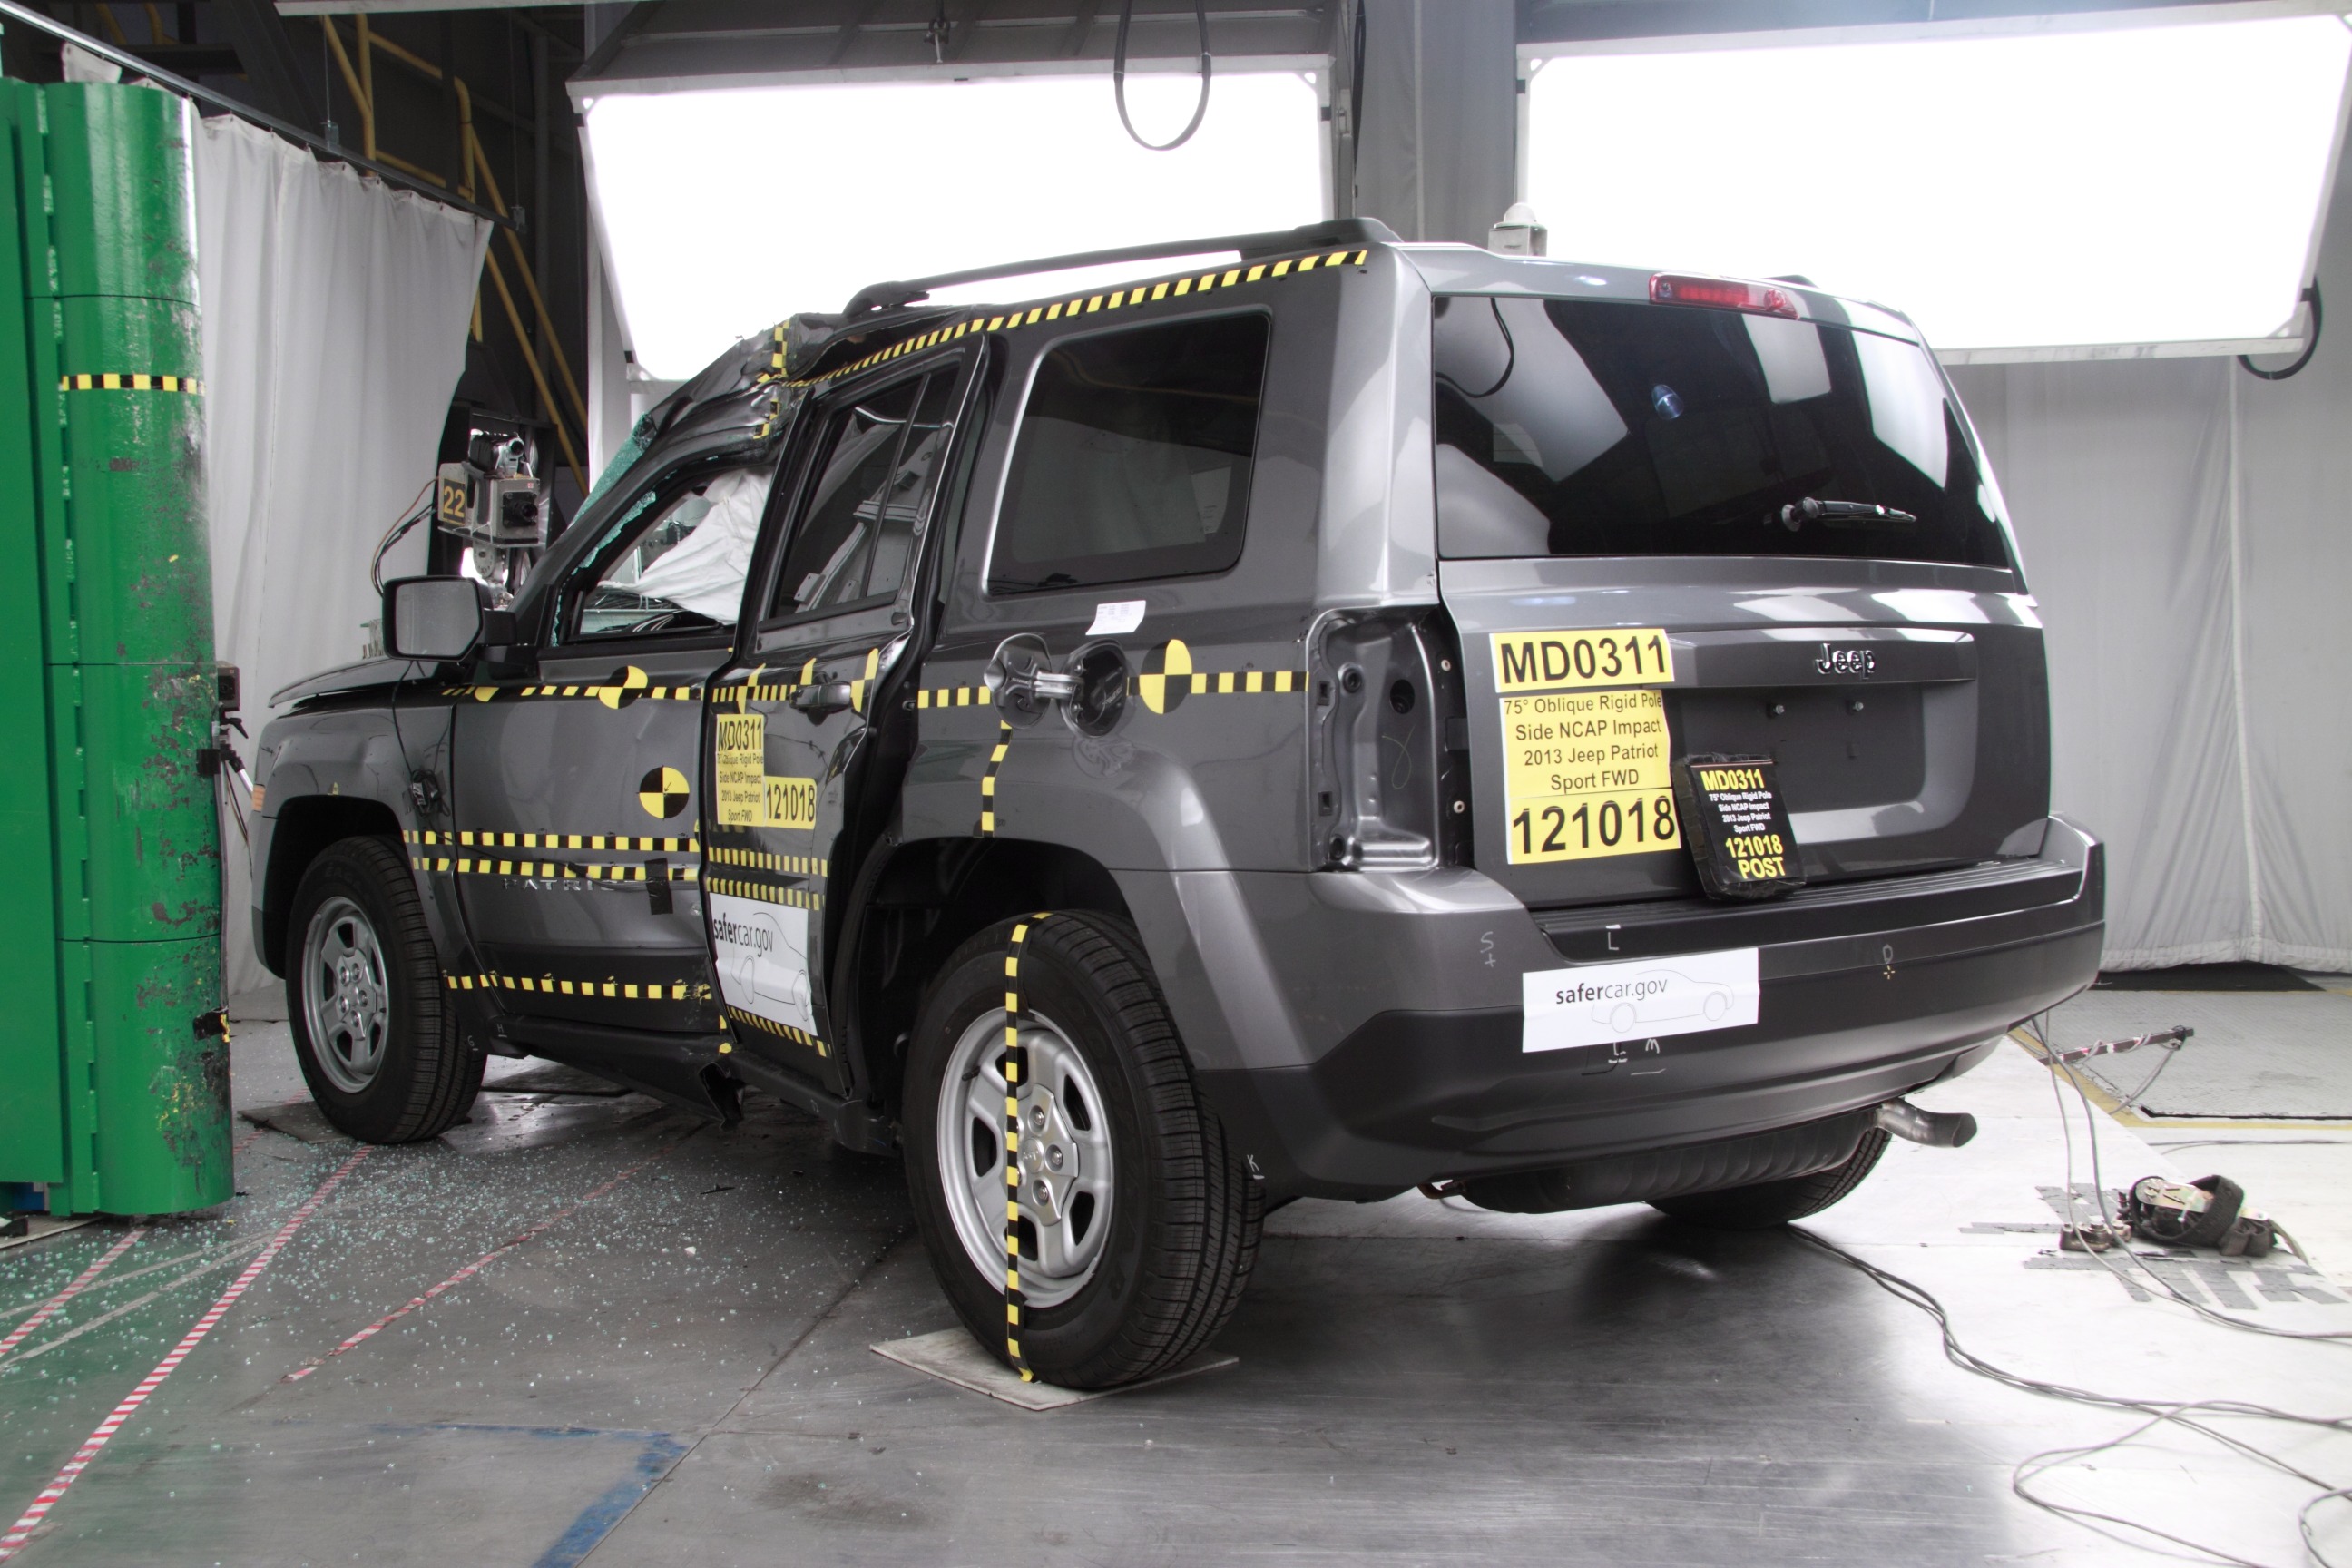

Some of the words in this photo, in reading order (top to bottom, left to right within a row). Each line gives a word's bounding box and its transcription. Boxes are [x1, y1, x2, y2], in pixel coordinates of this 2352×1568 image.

[443, 485, 466, 518] 22
[1500, 635, 1666, 685] MD0311
[1815, 642, 1876, 680] Jeep
[1504, 699, 1529, 715] 75°
[1534, 695, 1594, 717] Oblique
[1599, 692, 1637, 713] Rigid
[1642, 692, 1662, 709] Pole
[718, 718, 762, 751] MD0311
[1515, 720, 1553, 741] Side
[1559, 719, 1608, 738] NCAP
[1612, 718, 1661, 738] Impact
[740, 752, 752, 768] Rigid
[1524, 749, 1563, 767] 2013
[1567, 746, 1606, 767] Jeep
[1611, 743, 1659, 761] Patriot
[719, 771, 730, 783] Side
[730, 771, 744, 784] NCAP
[744, 771, 762, 788] Impact
[1551, 773, 1597, 794] Sport
[1602, 769, 1640, 786] FWD
[1700, 769, 1765, 791] MD0311
[721, 789, 732, 802] 2013
[732, 790, 744, 805] Jeep
[744, 790, 760, 803] Patriot
[767, 783, 815, 822] 121018
[1718, 803, 1731, 812] Side
[1731, 802, 1749, 811] NCAP
[1749, 801, 1770, 812] Impact
[1720, 791, 1742, 803] Oblique
[1741, 791, 1758, 802] Rigid
[1758, 790, 1772, 799] Pole
[728, 808, 740, 824] Sport
[740, 809, 753, 822] FWD
[1512, 795, 1675, 855] 121018
[1721, 814, 1737, 823] 2013
[1736, 813, 1751, 823] Jeep
[1750, 811, 1771, 821] Patriot
[1733, 824, 1750, 834] Sport
[1750, 822, 1766, 832] FWD
[1725, 834, 1783, 858] 121018
[1737, 856, 1786, 880] POST
[713, 912, 773, 957] safercar.gov
[1555, 978, 1669, 1004] safercar.gov
[1247, 1154, 1259, 1172] K
